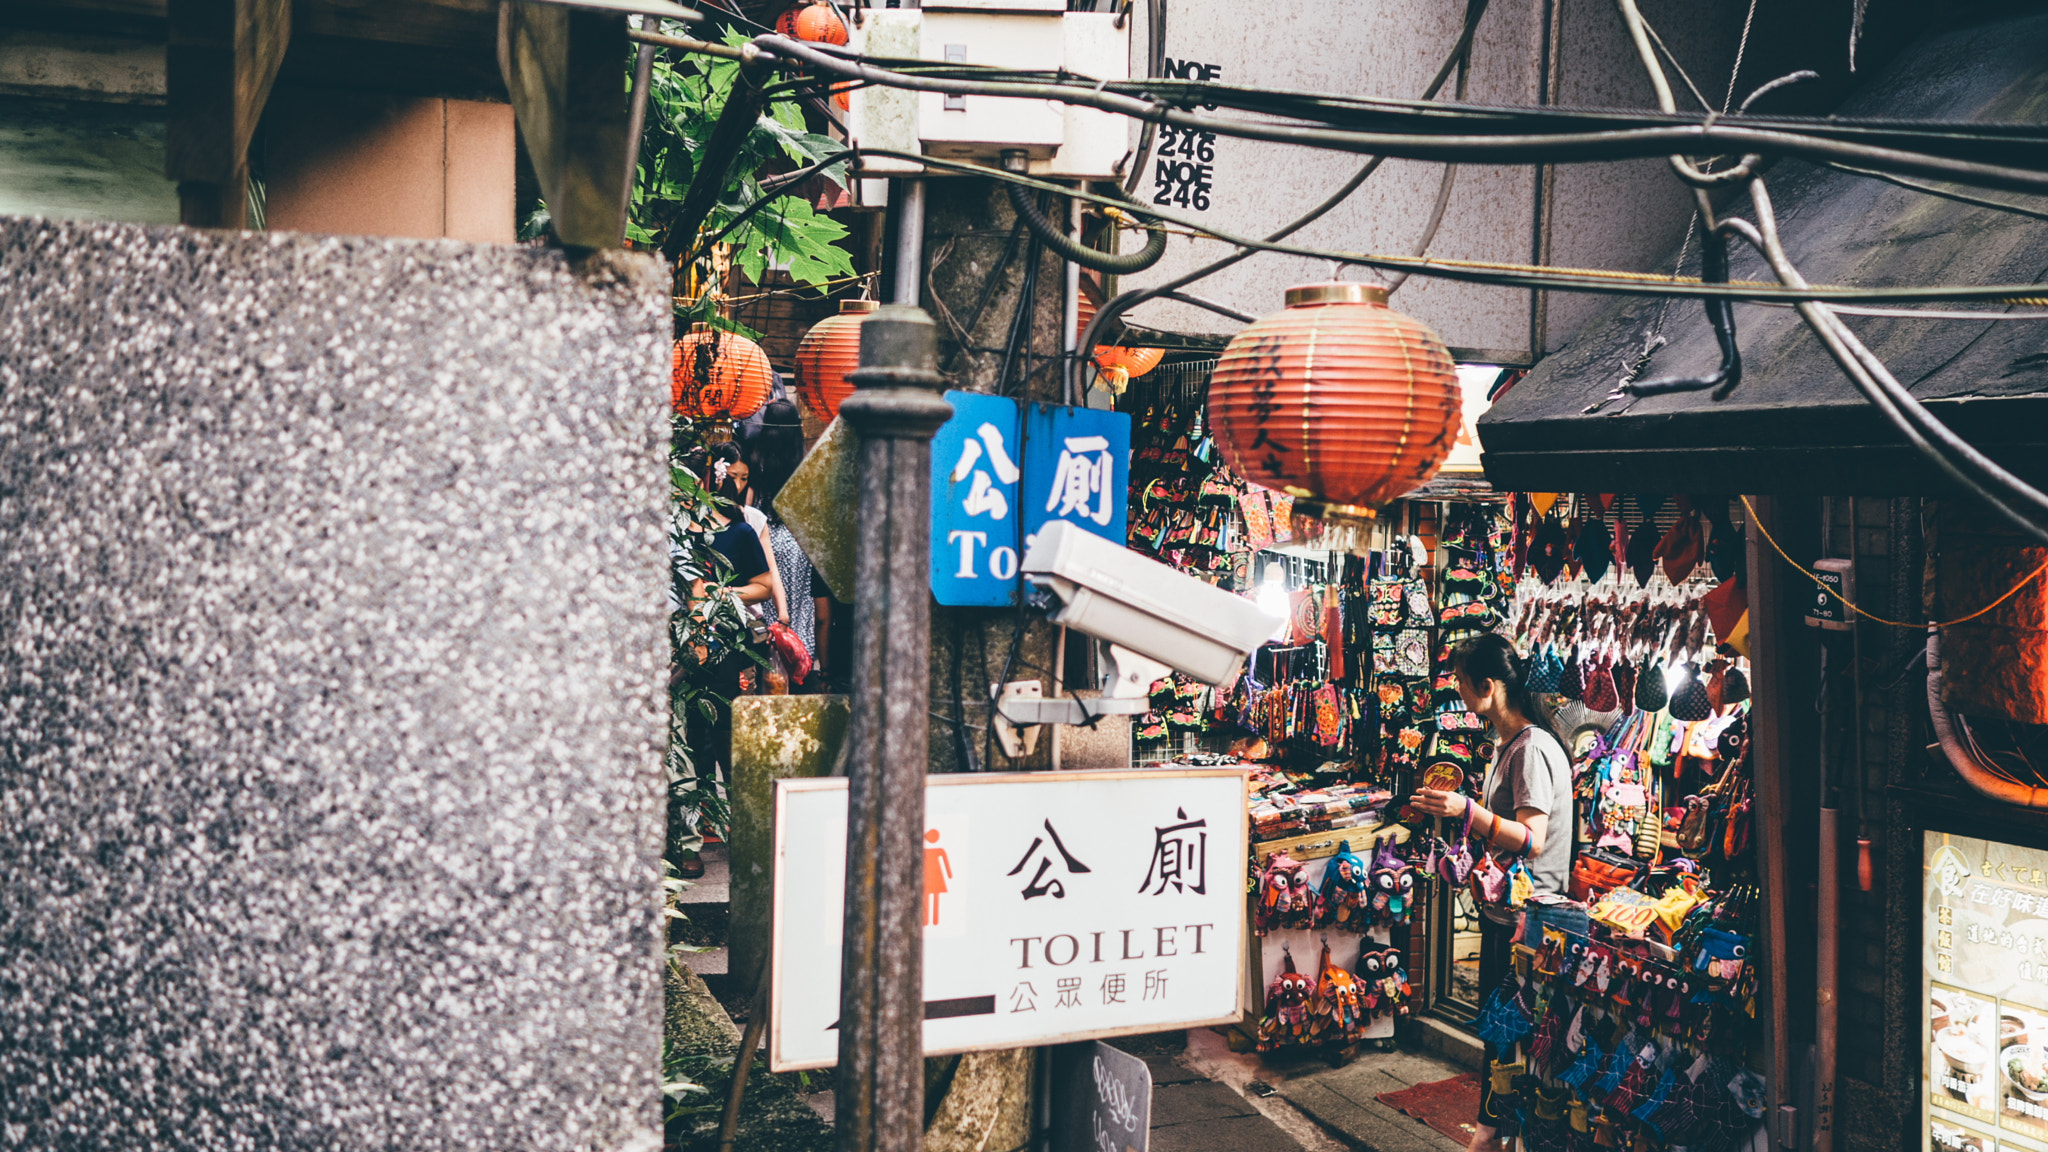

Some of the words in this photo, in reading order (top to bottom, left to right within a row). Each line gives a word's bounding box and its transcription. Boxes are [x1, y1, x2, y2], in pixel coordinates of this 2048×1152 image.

[1157, 131, 1216, 163] 246
[1155, 158, 1213, 188] NOE
[1153, 181, 1212, 211] 246
[949, 530, 1036, 580] To
[1007, 806, 1207, 901] 公廁
[1602, 904, 1653, 926] 100
[1010, 923, 1214, 970] TOILET
[1009, 968, 1169, 1014] 公眾便所
